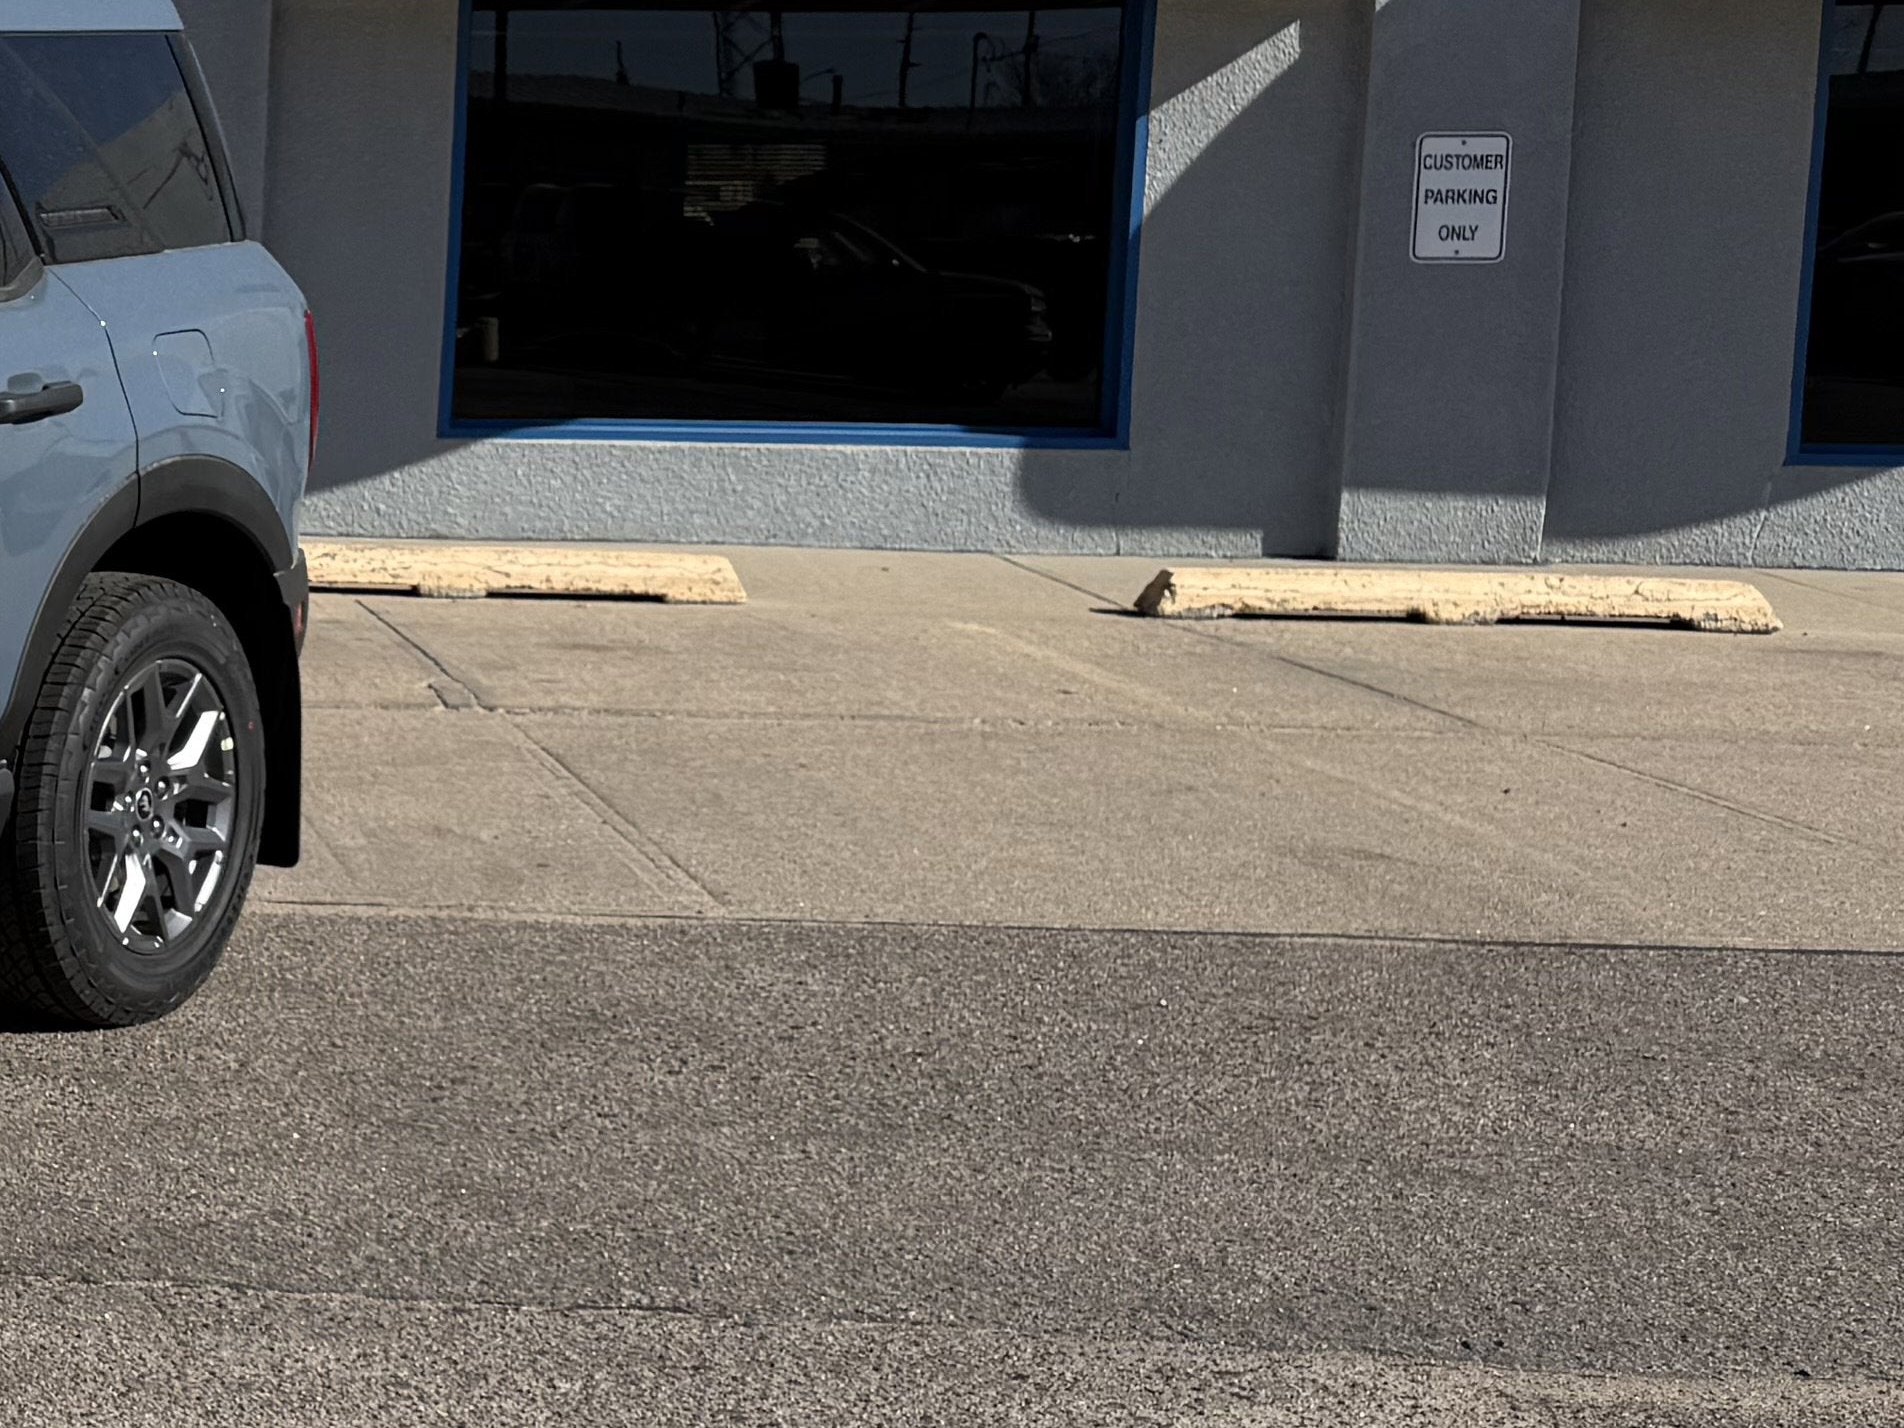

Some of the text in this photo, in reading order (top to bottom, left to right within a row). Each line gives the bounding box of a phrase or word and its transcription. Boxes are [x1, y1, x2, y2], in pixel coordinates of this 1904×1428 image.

[1423, 153, 1504, 171] CUSTOMER
[1423, 188, 1498, 205] PARKING
[1438, 224, 1479, 242] ONLY
